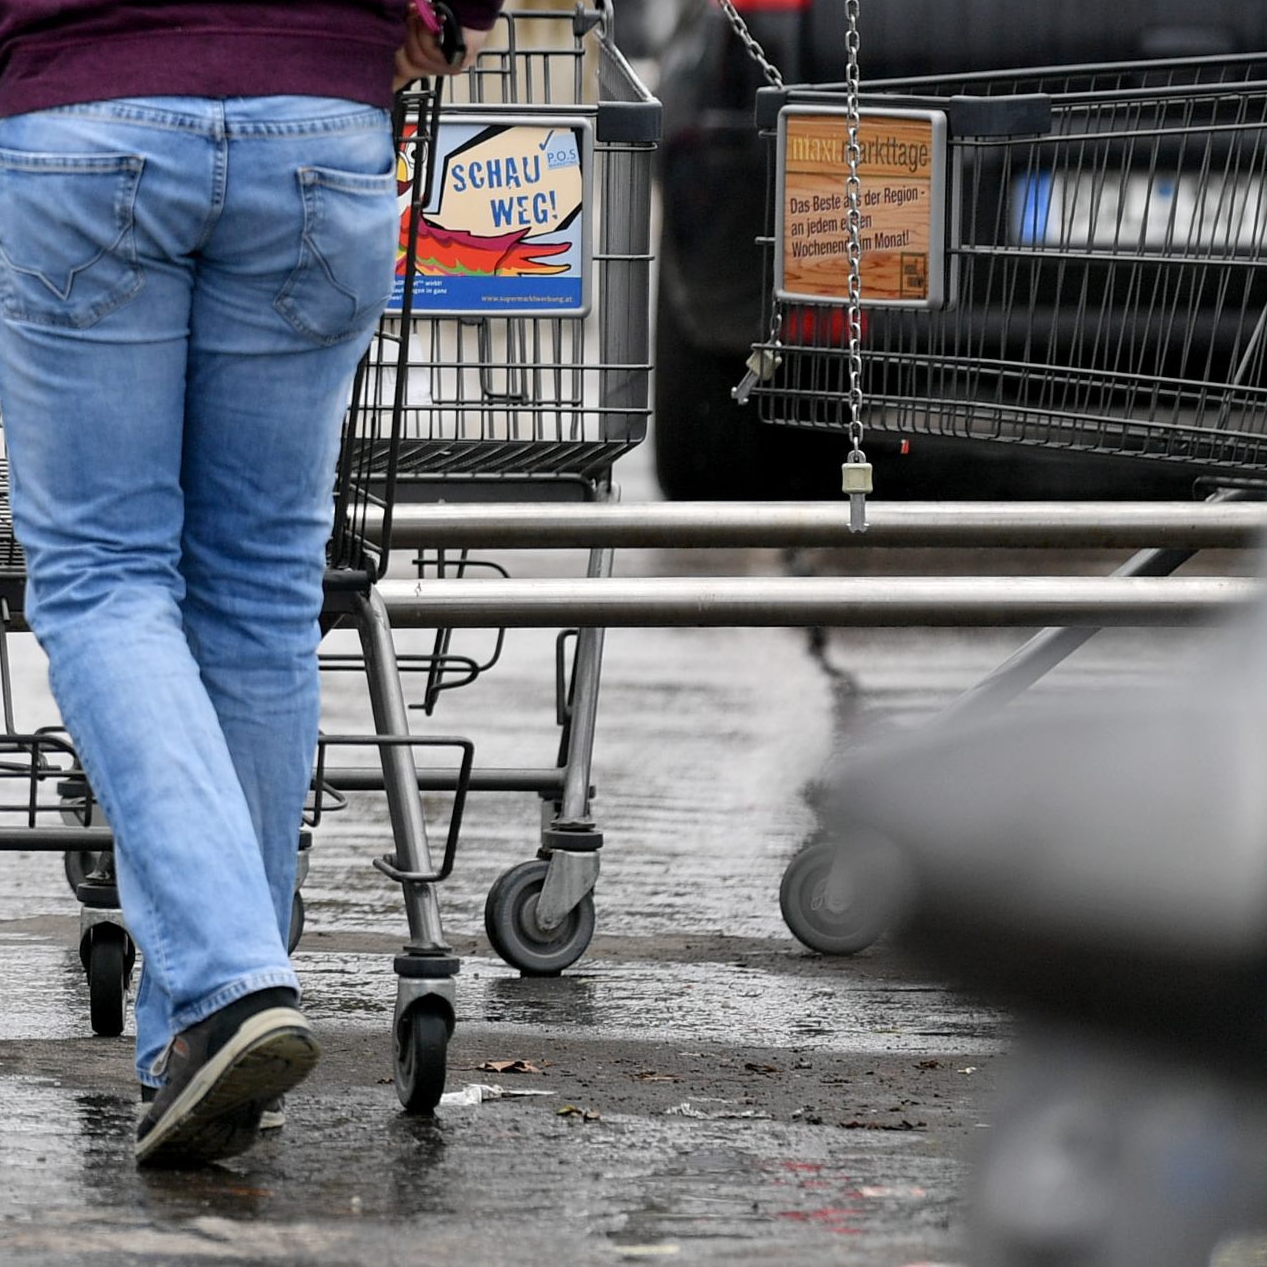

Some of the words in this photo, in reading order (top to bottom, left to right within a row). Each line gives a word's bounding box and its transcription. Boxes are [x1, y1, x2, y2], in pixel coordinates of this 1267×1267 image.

[451, 155, 540, 192] SCHAU
[490, 190, 558, 227] WEG!
[790, 198, 810, 214] Das
[813, 194, 840, 212] Beste
[843, 196, 861, 209] as
[864, 189, 881, 206] der
[884, 185, 918, 206] Region
[791, 222, 804, 236] an
[806, 218, 838, 239] jedem
[840, 215, 872, 232] een
[792, 237, 857, 258] Wochenend
[860, 236, 872, 251] im
[875, 229, 909, 248] Monat!
